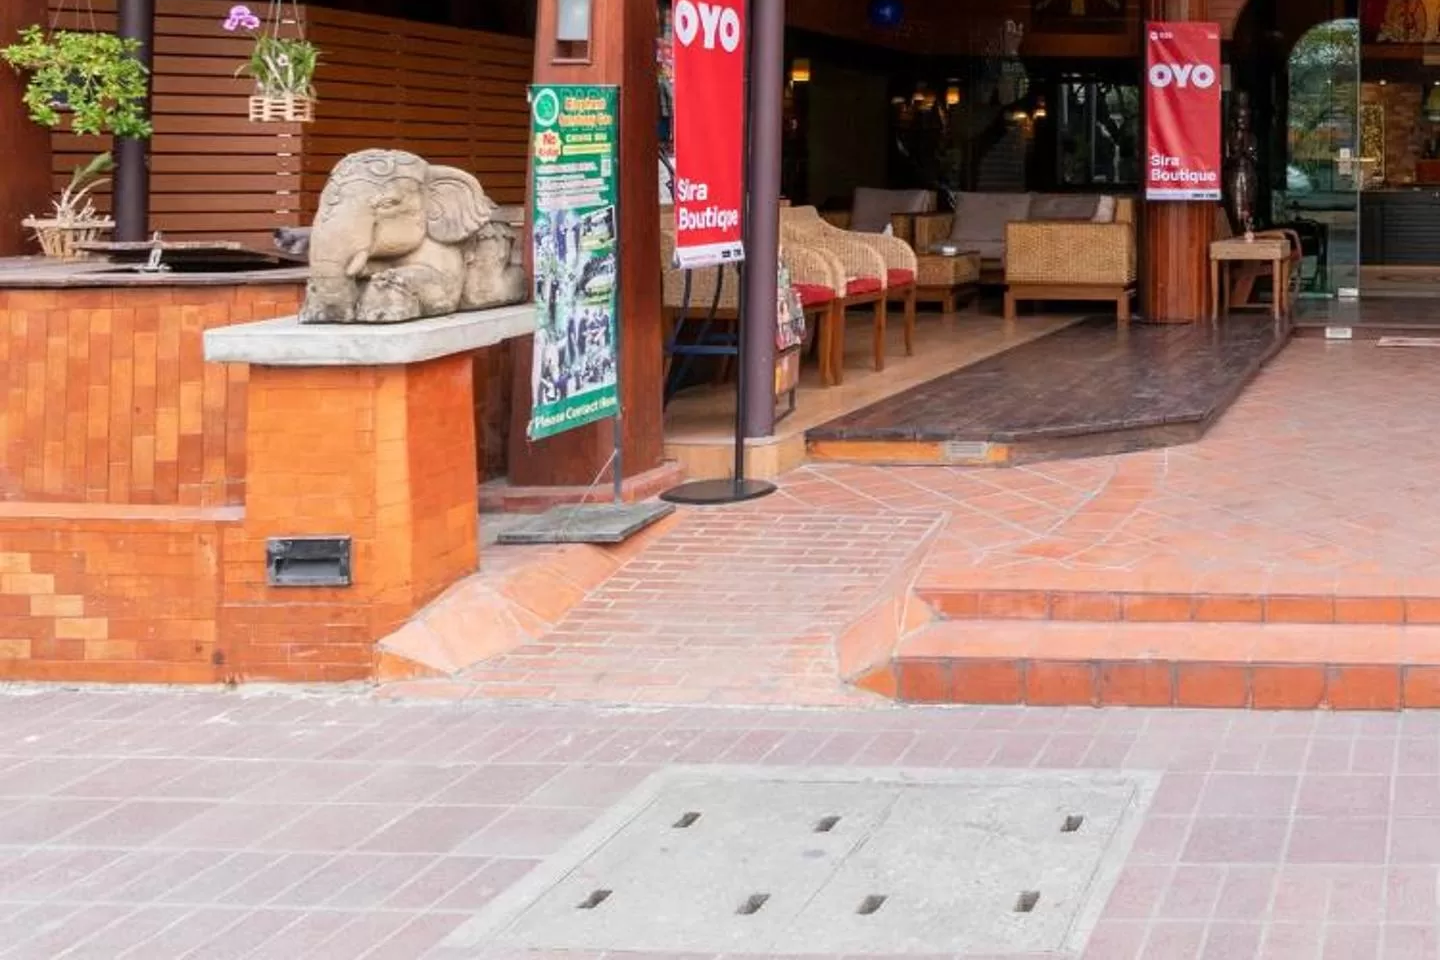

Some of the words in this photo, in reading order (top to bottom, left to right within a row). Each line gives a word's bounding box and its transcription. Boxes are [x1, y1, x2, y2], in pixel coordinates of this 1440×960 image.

[675, 0, 741, 53] OYO
[1150, 63, 1216, 89] OYO
[1151, 155, 1180, 167] Sira
[1151, 168, 1217, 184] Boutique
[677, 178, 708, 201] Sira
[679, 205, 739, 233] Boutique
